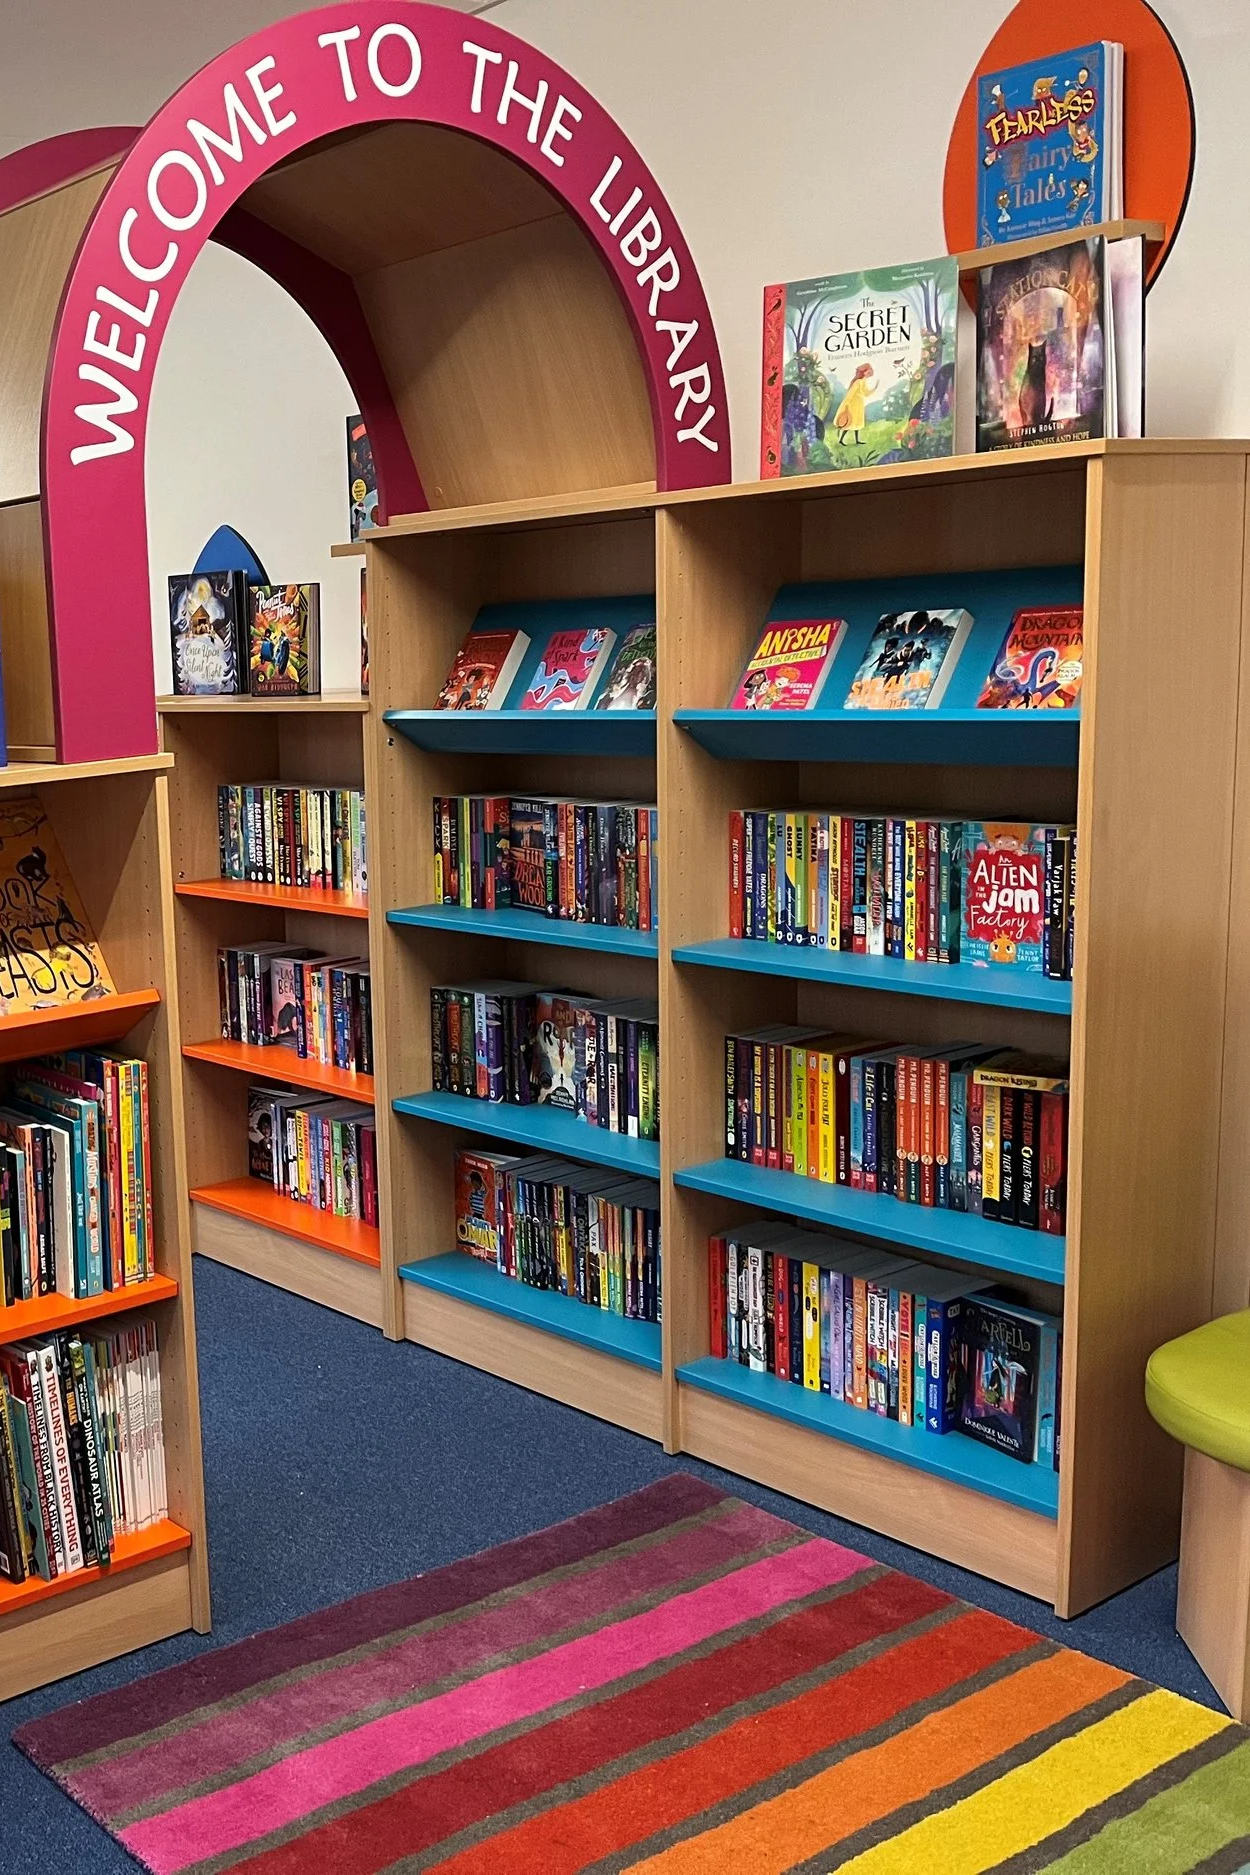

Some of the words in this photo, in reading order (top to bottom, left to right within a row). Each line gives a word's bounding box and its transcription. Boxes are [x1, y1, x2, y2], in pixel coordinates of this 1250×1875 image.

[986, 90, 1095, 145] FEARLESS
[1010, 178, 1066, 209] Tales
[70, 55, 296, 468] WELCOME
[318, 22, 422, 101] TO
[462, 41, 582, 166] THE
[590, 156, 719, 454] LIBRARY
[861, 297, 874, 308] The
[829, 305, 909, 333] SECRET
[825, 324, 911, 352] GARDEN
[754, 624, 832, 659] ANISHA
[254, 803, 262, 836] AGAINST
[442, 816, 450, 848] SPARK
[256, 843, 264, 867] GODS
[785, 826, 794, 858] GHOST
[795, 826, 804, 860] SUNNY
[809, 826, 819, 863] PATINA
[853, 822, 868, 876] STEALTH
[974, 859, 1038, 887] ALIEN
[1051, 864, 1064, 896] Yarjak
[982, 884, 1040, 914] jam
[1052, 898, 1062, 916] Paw
[971, 905, 1029, 939] Factory
[938, 1063, 946, 1075] MR.
[981, 1074, 1009, 1084] DRAGON
[937, 1076, 947, 1106] PENGUIN
[31, 1381, 47, 1440] TIMELINES
[45, 1373, 65, 1447] TIMELINES
[39, 1442, 51, 1471] FROM
[56, 1448, 66, 1465] OF
[82, 1419, 100, 1481] DINOSAUR
[91, 1482, 104, 1518] ATLAS
[43, 1473, 57, 1508] BLACK
[57, 1467, 79, 1552] EVERYTHING
[48, 1509, 64, 1555] HISTORY
